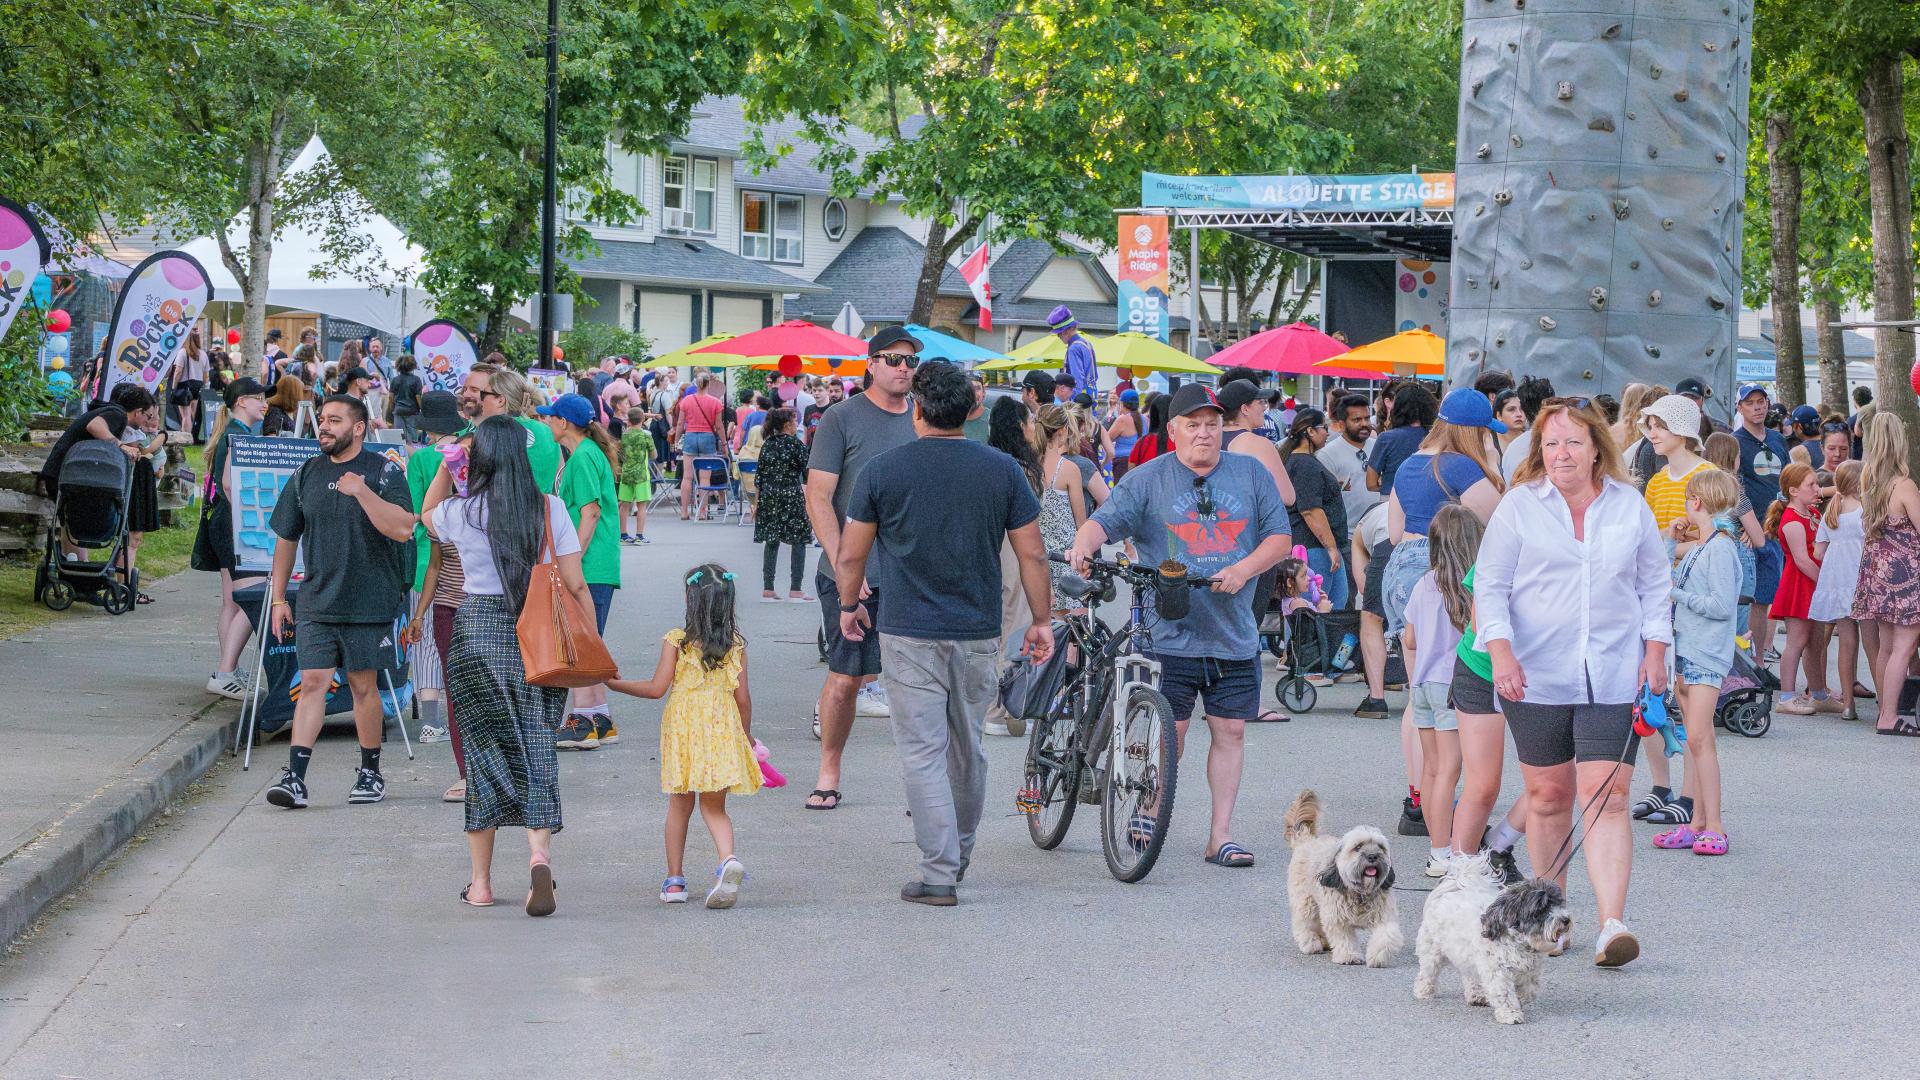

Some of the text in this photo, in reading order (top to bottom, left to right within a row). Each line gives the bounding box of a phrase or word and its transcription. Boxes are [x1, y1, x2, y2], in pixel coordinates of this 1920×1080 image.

[1263, 181, 1447, 202] ALOUETTE STAGE
[1128, 248, 1160, 261] Maple
[1130, 260, 1158, 272] Ridge
[164, 304, 179, 318] the
[150, 310, 195, 372] BLOCK
[236, 449, 253, 457] Maple
[253, 450, 268, 458] Ridge
[268, 644, 297, 656] driven
